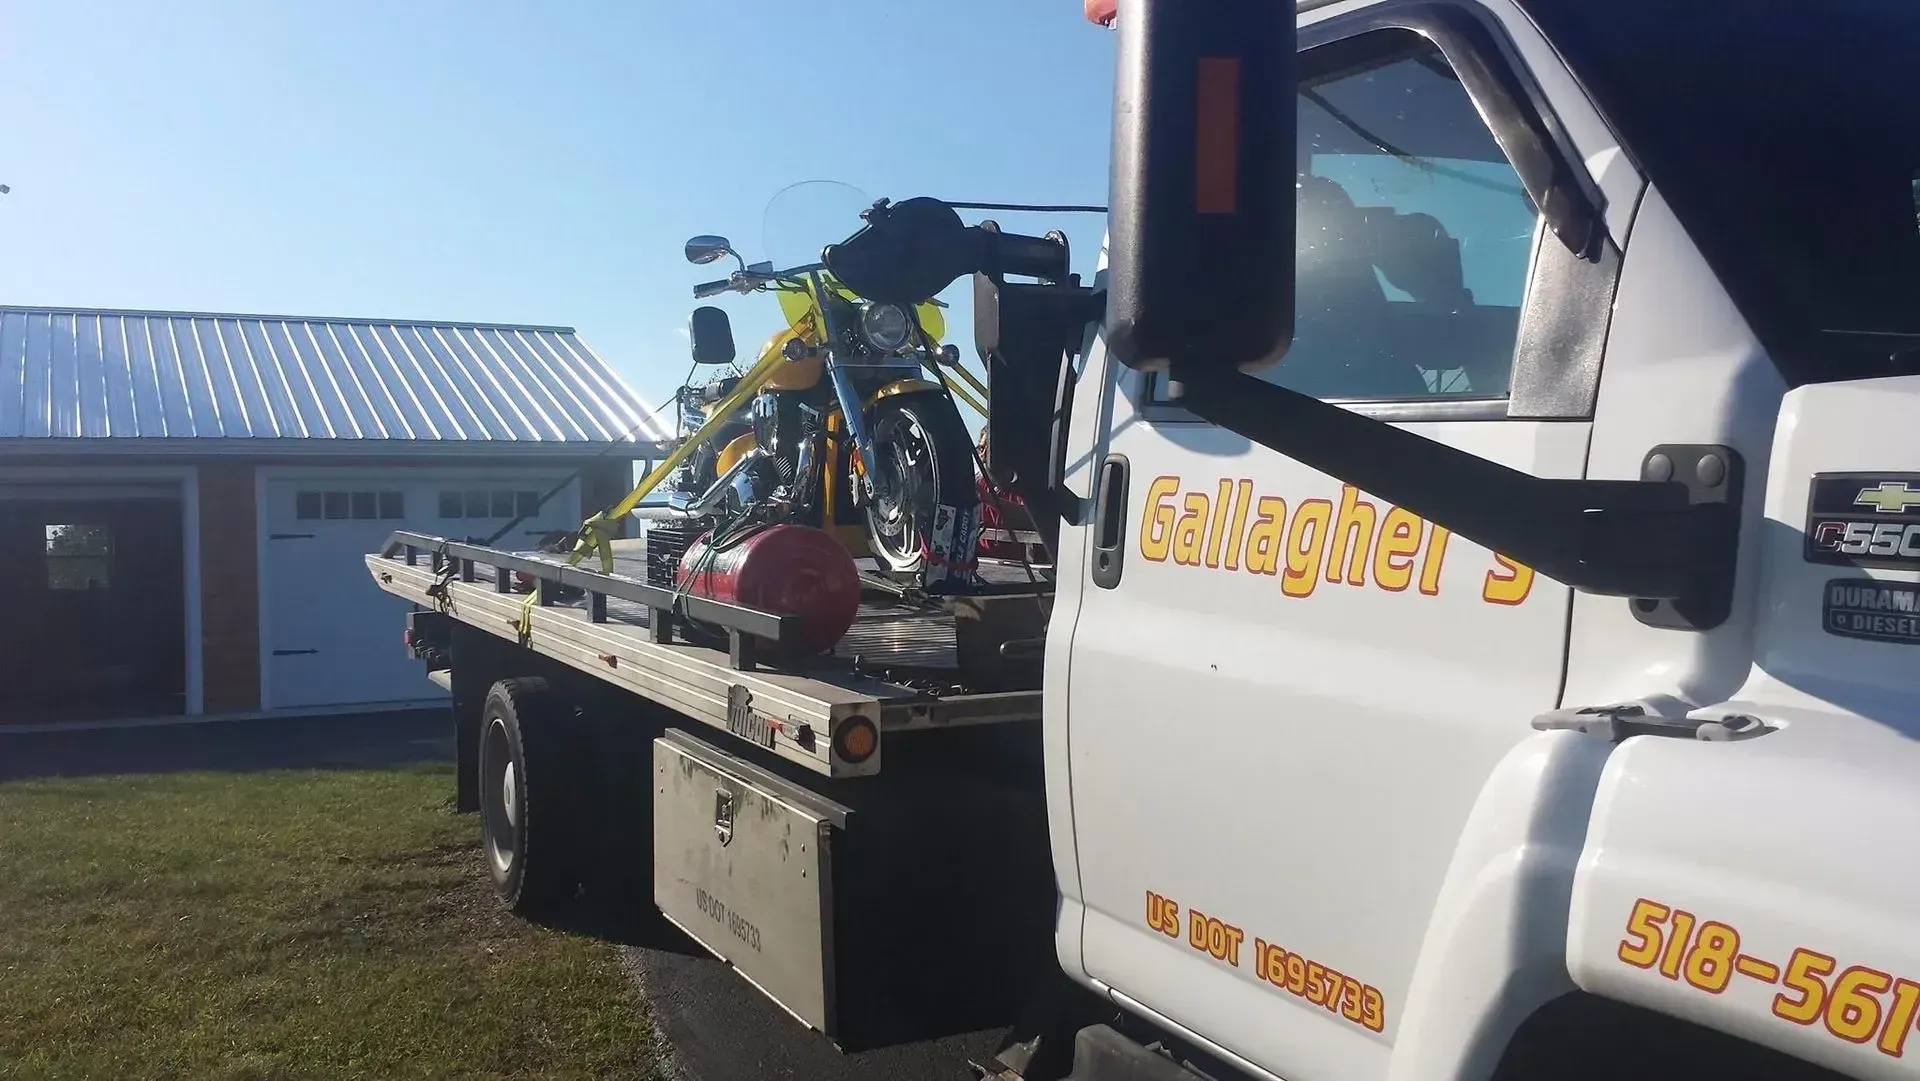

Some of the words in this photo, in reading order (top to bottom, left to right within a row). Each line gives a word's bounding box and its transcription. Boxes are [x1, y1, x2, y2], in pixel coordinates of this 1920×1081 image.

[1139, 475, 1536, 606] Gallaghers
[1831, 586, 1920, 613] DURAM
[1852, 615, 1920, 635] DIESEL
[696, 887, 707, 913] US
[709, 894, 725, 923] DOT
[727, 909, 761, 953] 1695733
[1145, 890, 1180, 939] US
[1188, 908, 1244, 968] DOT
[1254, 936, 1385, 1034] 1695733
[1617, 897, 1920, 1058] 518-561
